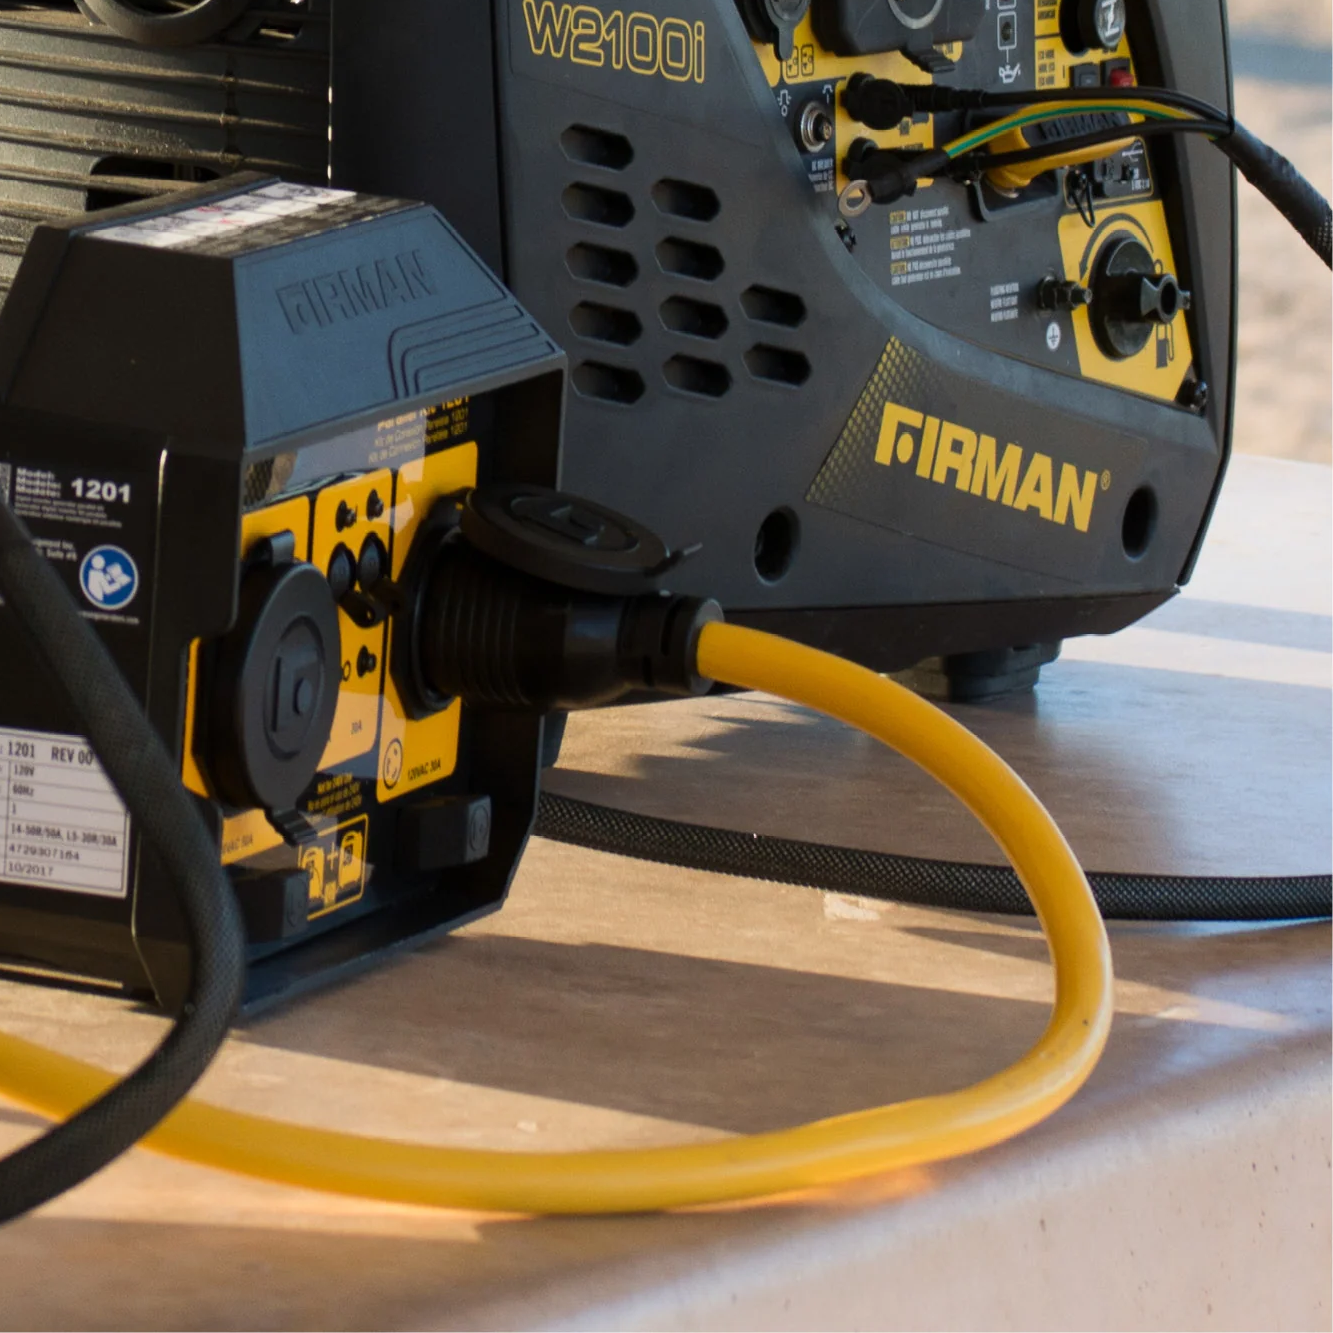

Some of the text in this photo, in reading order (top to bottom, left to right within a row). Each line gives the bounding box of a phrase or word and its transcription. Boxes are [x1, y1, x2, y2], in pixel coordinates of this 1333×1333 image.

[275, 249, 437, 334] FIRMAN
[874, 401, 1098, 533] FIRMAN
[71, 478, 131, 504] 1201
[7, 741, 35, 758] 1201
[51, 746, 74, 763] REV
[14, 765, 35, 777] 120V
[12, 784, 34, 797] 60Hz
[8, 861, 54, 877] 10/2017
